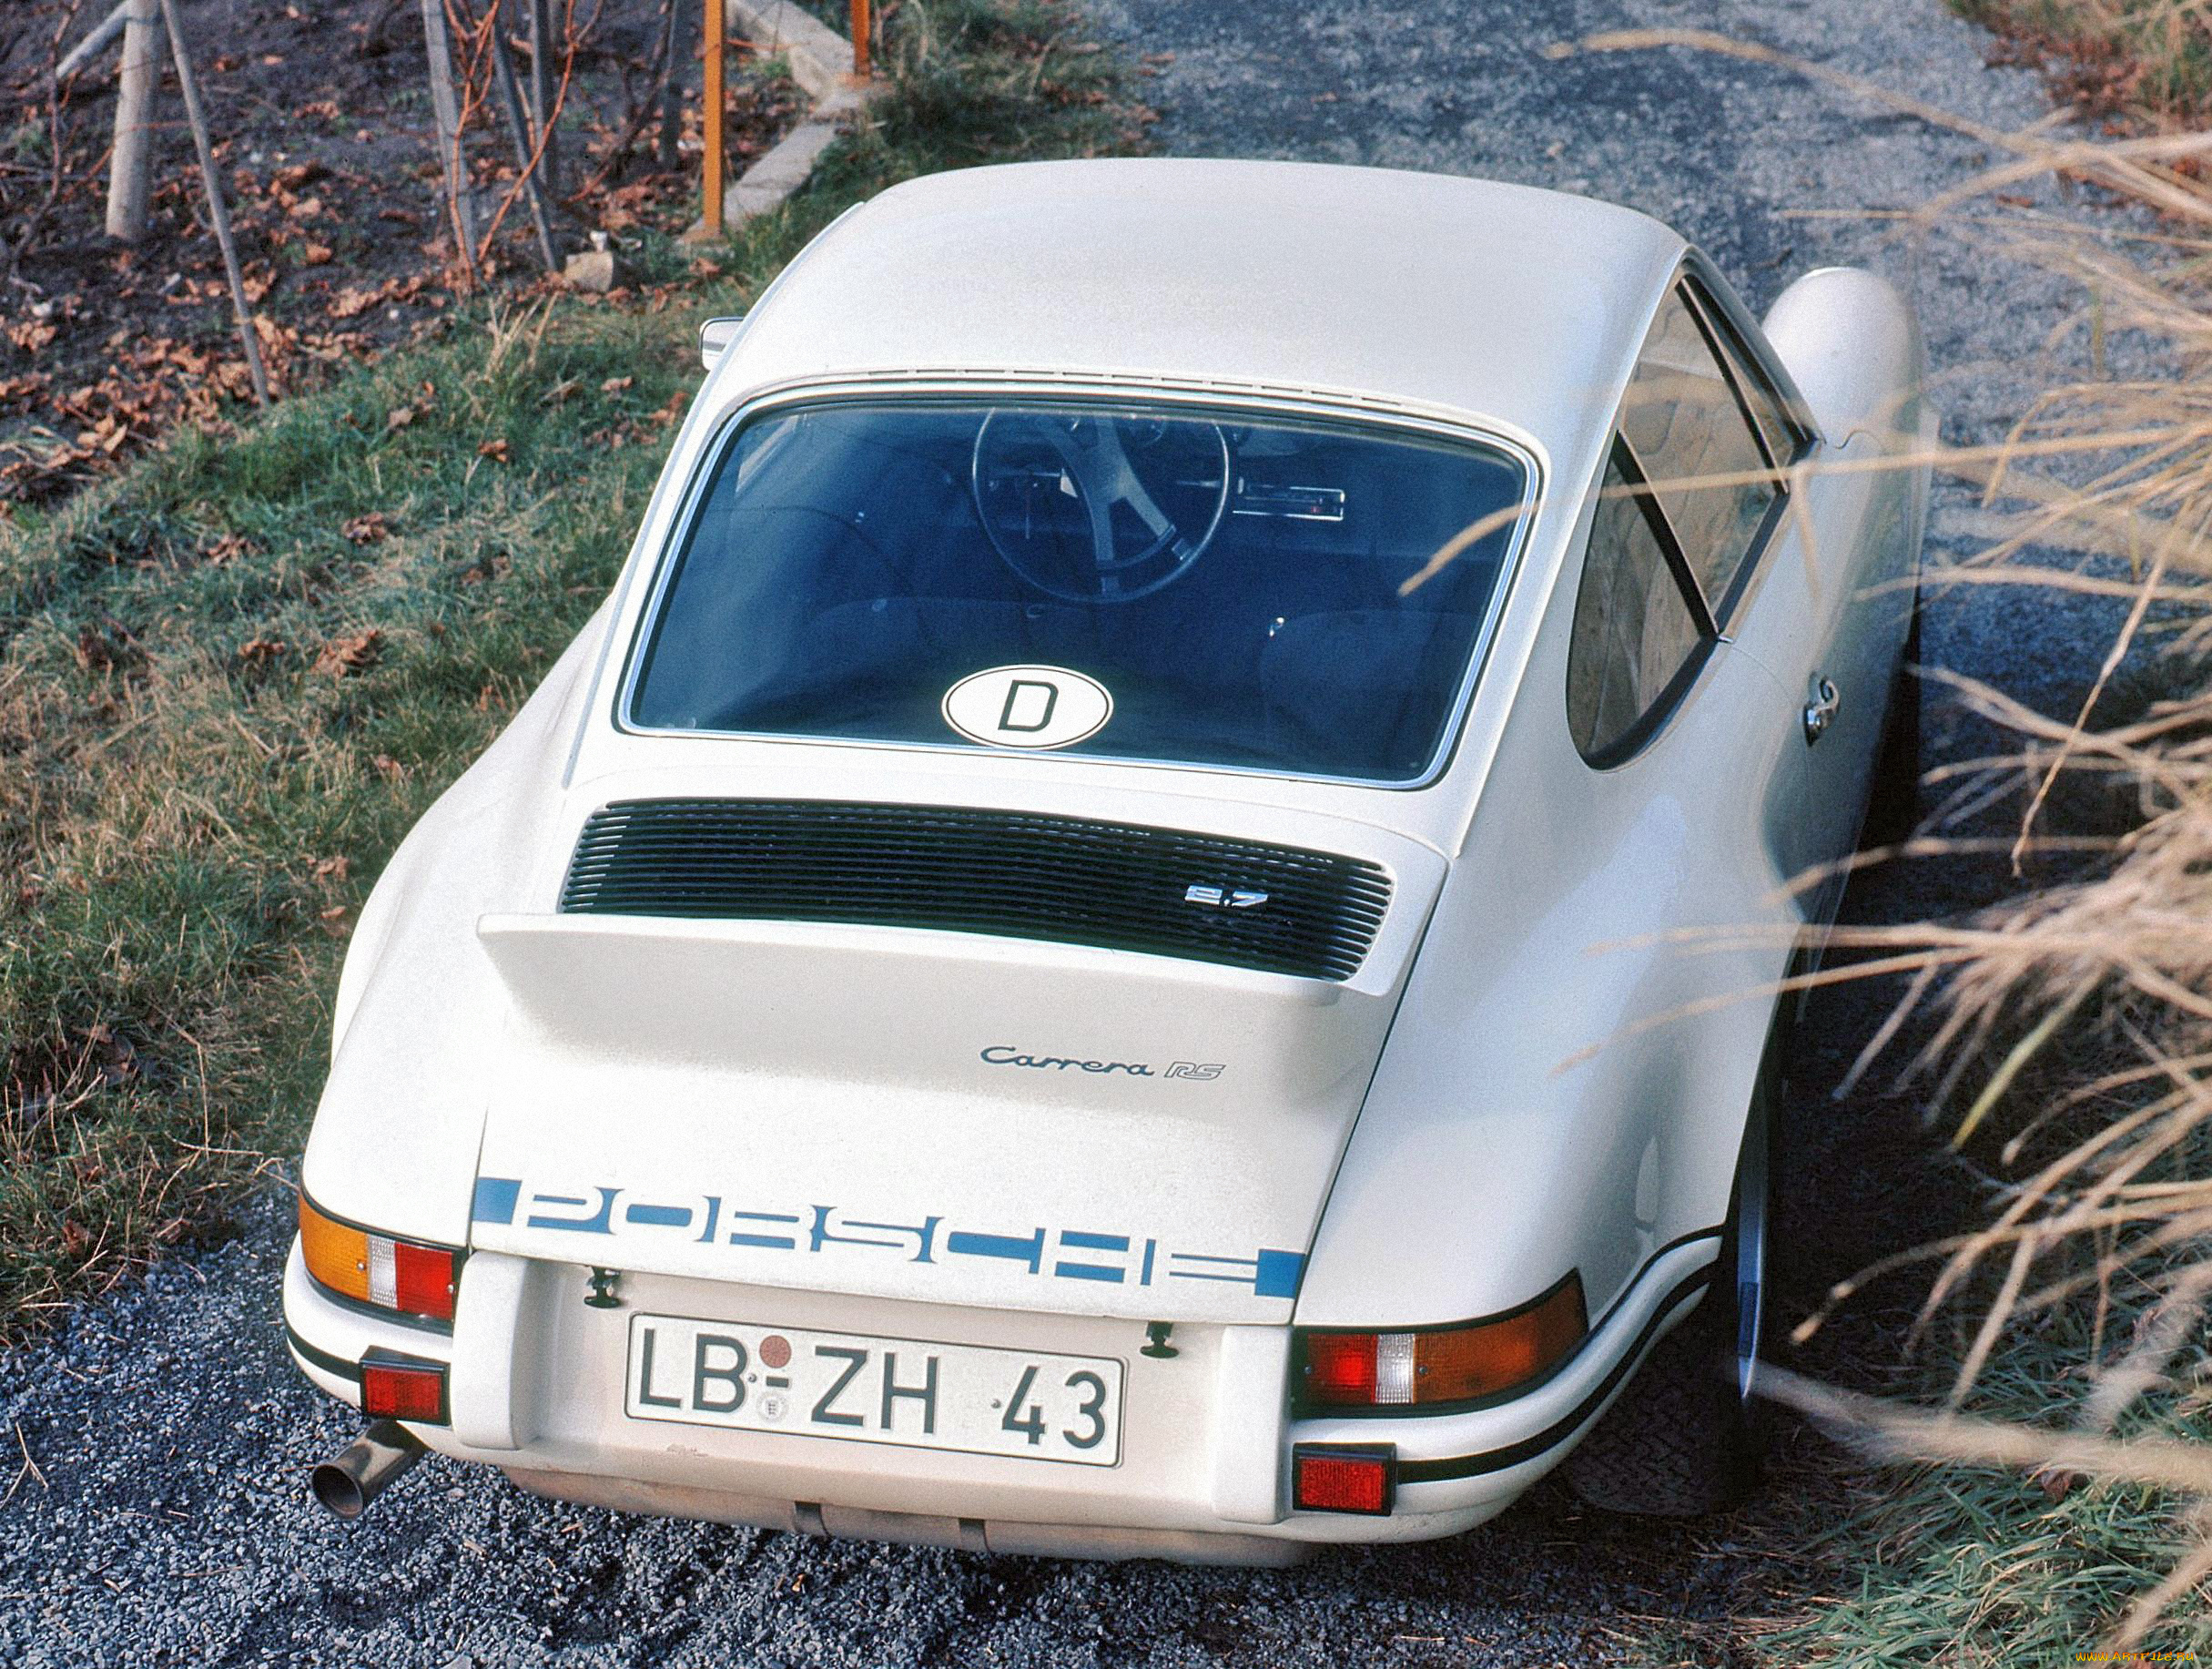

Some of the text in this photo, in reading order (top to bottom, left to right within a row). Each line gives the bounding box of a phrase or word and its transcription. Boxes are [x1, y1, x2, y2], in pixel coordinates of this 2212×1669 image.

[998, 679, 1060, 733] D
[980, 1046, 1226, 1081] Carrera RS
[515, 1180, 1256, 1293] PORSCHE
[1000, 1365, 1106, 1450] 43
